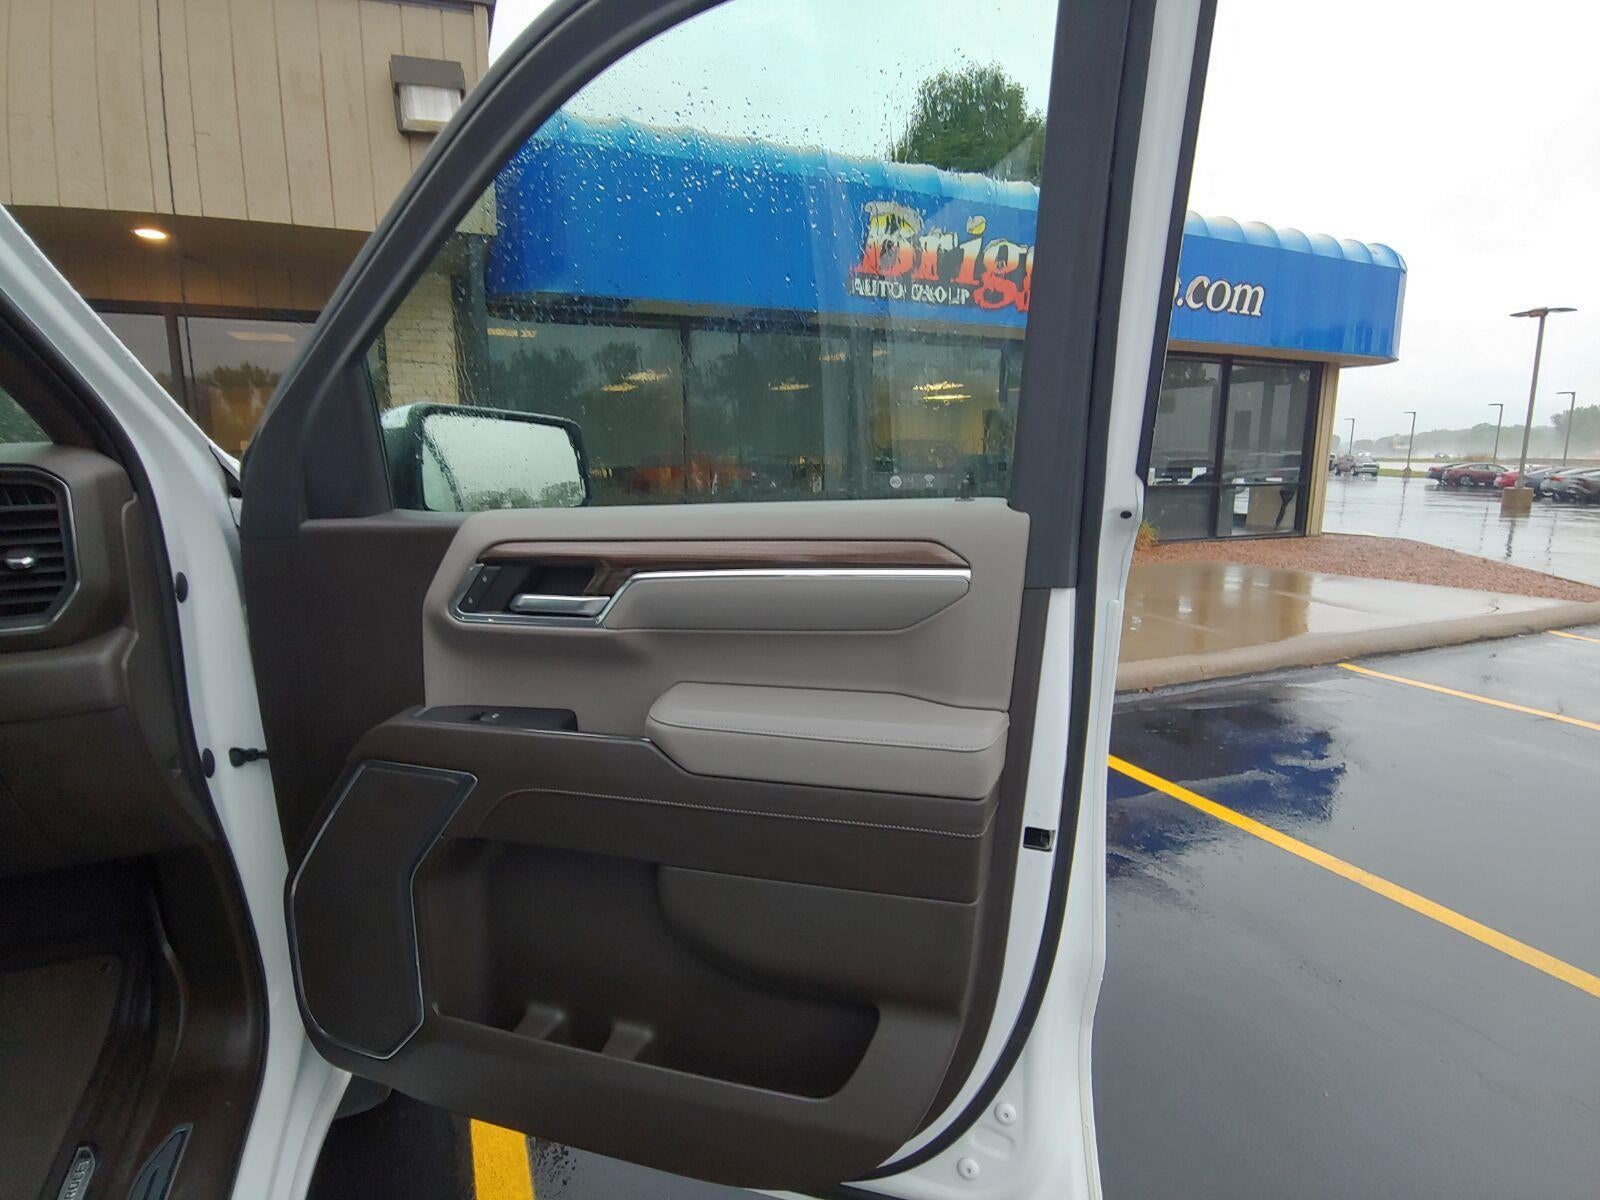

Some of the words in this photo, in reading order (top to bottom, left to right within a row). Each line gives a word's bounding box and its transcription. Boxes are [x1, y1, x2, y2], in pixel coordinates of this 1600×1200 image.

[851, 277, 905, 299] AUTO
[911, 283, 971, 305] GROUP
[852, 201, 1034, 312] Brig
[1174, 275, 1265, 317] .com
